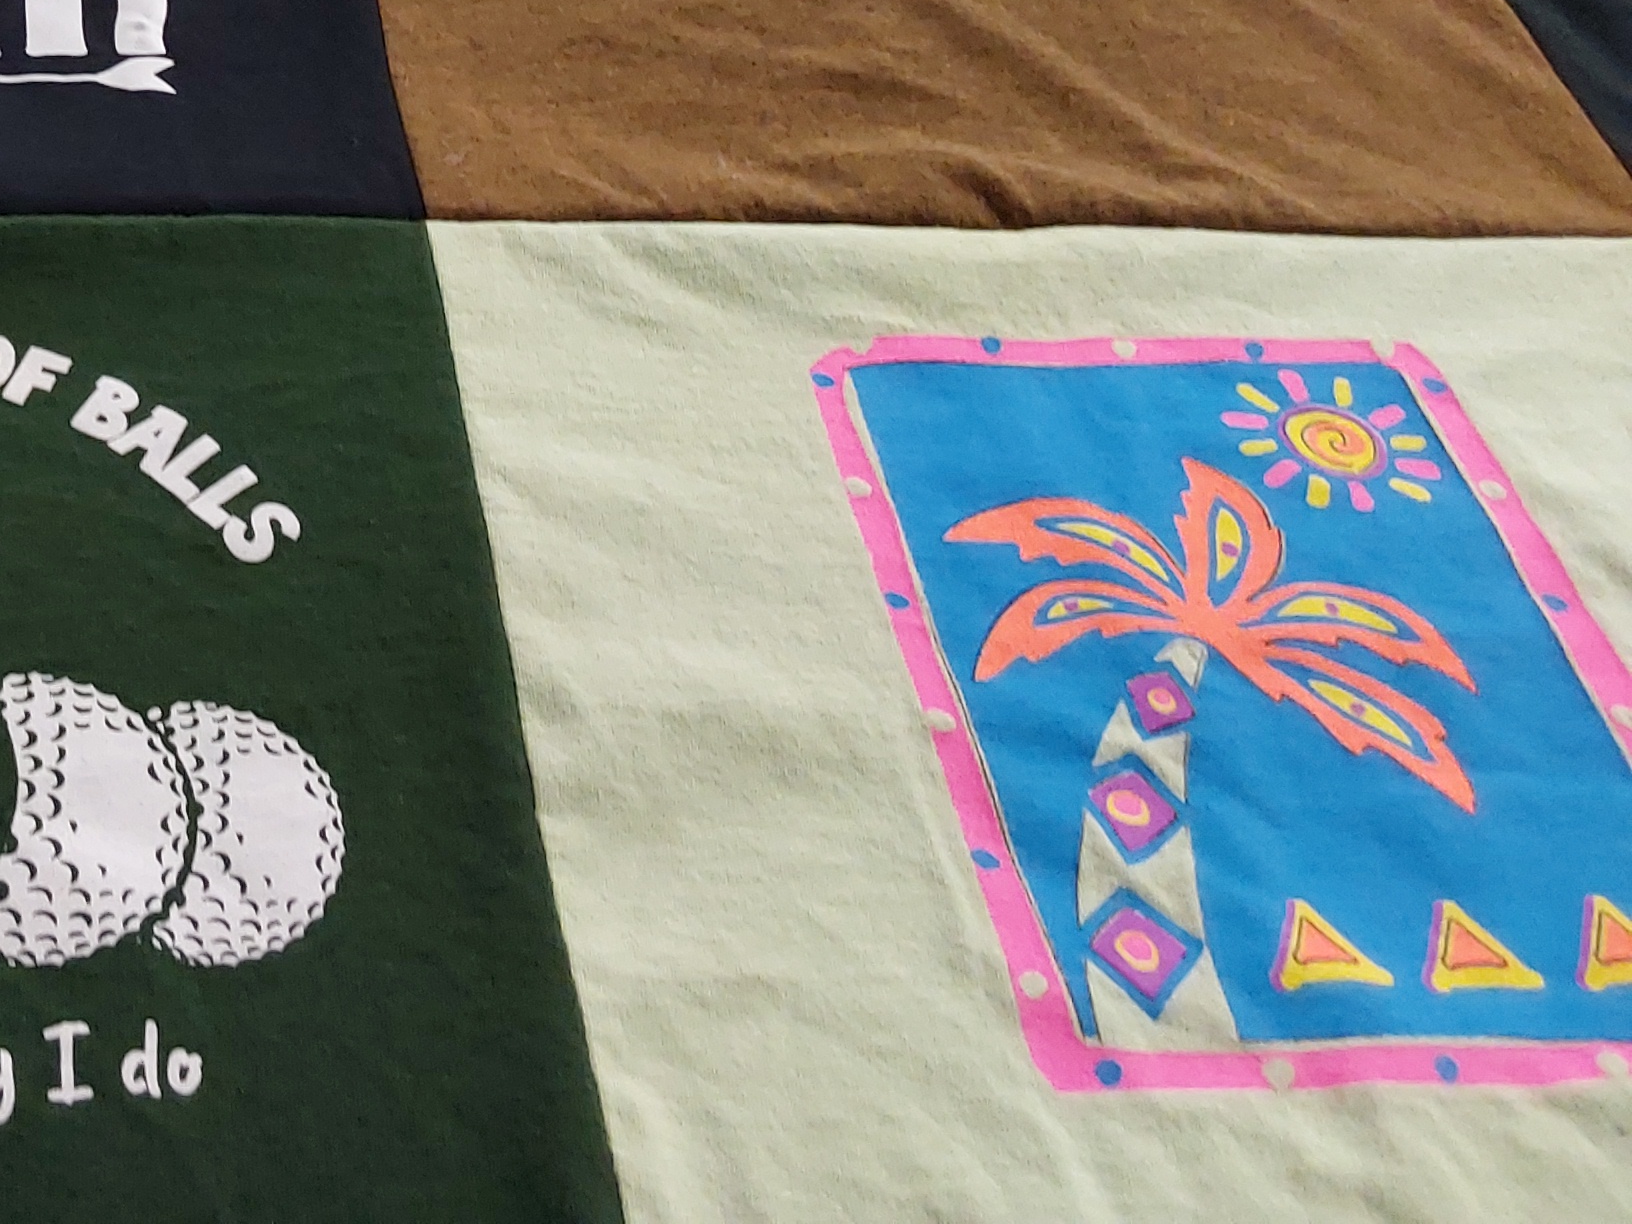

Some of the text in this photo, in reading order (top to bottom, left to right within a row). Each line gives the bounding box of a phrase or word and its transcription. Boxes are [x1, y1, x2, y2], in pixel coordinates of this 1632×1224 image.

[70, 374, 302, 564] BALLS
[42, 1020, 94, 1106] I
[120, 1018, 204, 1099] do
